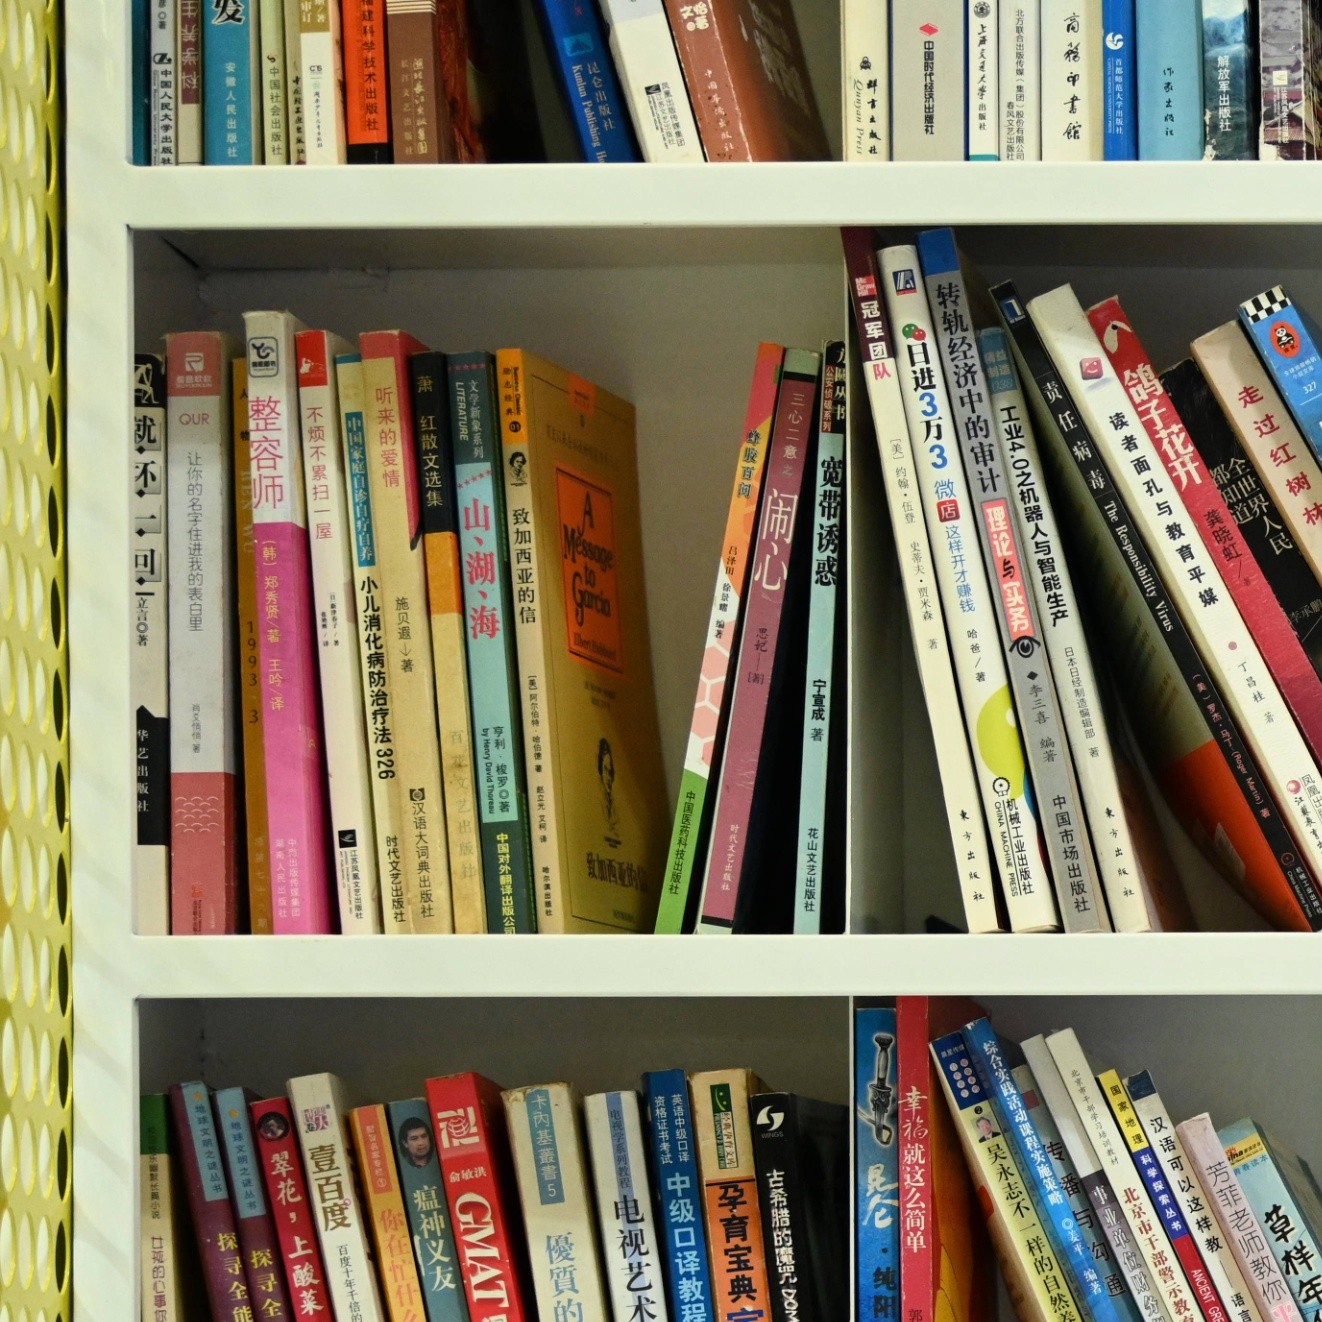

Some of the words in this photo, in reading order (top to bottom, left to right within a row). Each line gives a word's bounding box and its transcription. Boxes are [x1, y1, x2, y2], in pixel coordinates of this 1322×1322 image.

[226, 62, 238, 157] 安徽人民出版社
[270, 66, 282, 156] 中国社会出版社
[572, 64, 587, 98] Kunlun
[924, 41, 934, 135] 中国时代经济出版社
[1217, 55, 1232, 132] 解放军出版社
[861, 301, 890, 379] 冠军团队
[936, 283, 999, 494] 转轨经济中的审计
[1303, 380, 1318, 395] 327
[248, 396, 285, 510] 整容师
[375, 386, 401, 488] 听来的爱情
[455, 382, 468, 441] LITERATURE
[907, 343, 949, 469] 日进3万3
[1042, 382, 1106, 489] 责任病毒
[1123, 363, 1203, 491] 鸽子花开
[306, 406, 334, 540] 不烦不累扫一屋
[815, 456, 843, 587] 宽带诱惑
[1000, 405, 1069, 627] 工业4.0之机器人与智能生产
[1108, 411, 1220, 608] 读者面孔与教育平媒
[513, 507, 537, 624] 致加西亚的信
[754, 488, 798, 592] 闹心
[986, 506, 1031, 632] 理论与实务
[811, 679, 826, 721] 宁宣成
[411, 802, 435, 918] 汉语大词典出版社
[669, 790, 696, 895] 中国医药科技出版社
[804, 828, 819, 912] 花山文艺出版社
[1006, 798, 1035, 895] 机械工业出版社
[1052, 794, 1090, 913] 中国市场出版社
[898, 1085, 928, 1254] 幸福就这么简单
[981, 1040, 1064, 1207] 综合实践活动课程实施策略
[1111, 1084, 1145, 1147] 国家地理
[1140, 1153, 1183, 1231] 科学探索丛书
[310, 1144, 352, 1232] 壹百度
[413, 1184, 457, 1292] 瘟神义友
[766, 1169, 797, 1284] 古希腊的魔咒
[1149, 1117, 1224, 1254] 汉语可以这样教
[1206, 1162, 1286, 1305] 芳菲老师教你
[455, 1191, 510, 1308] GMAT
